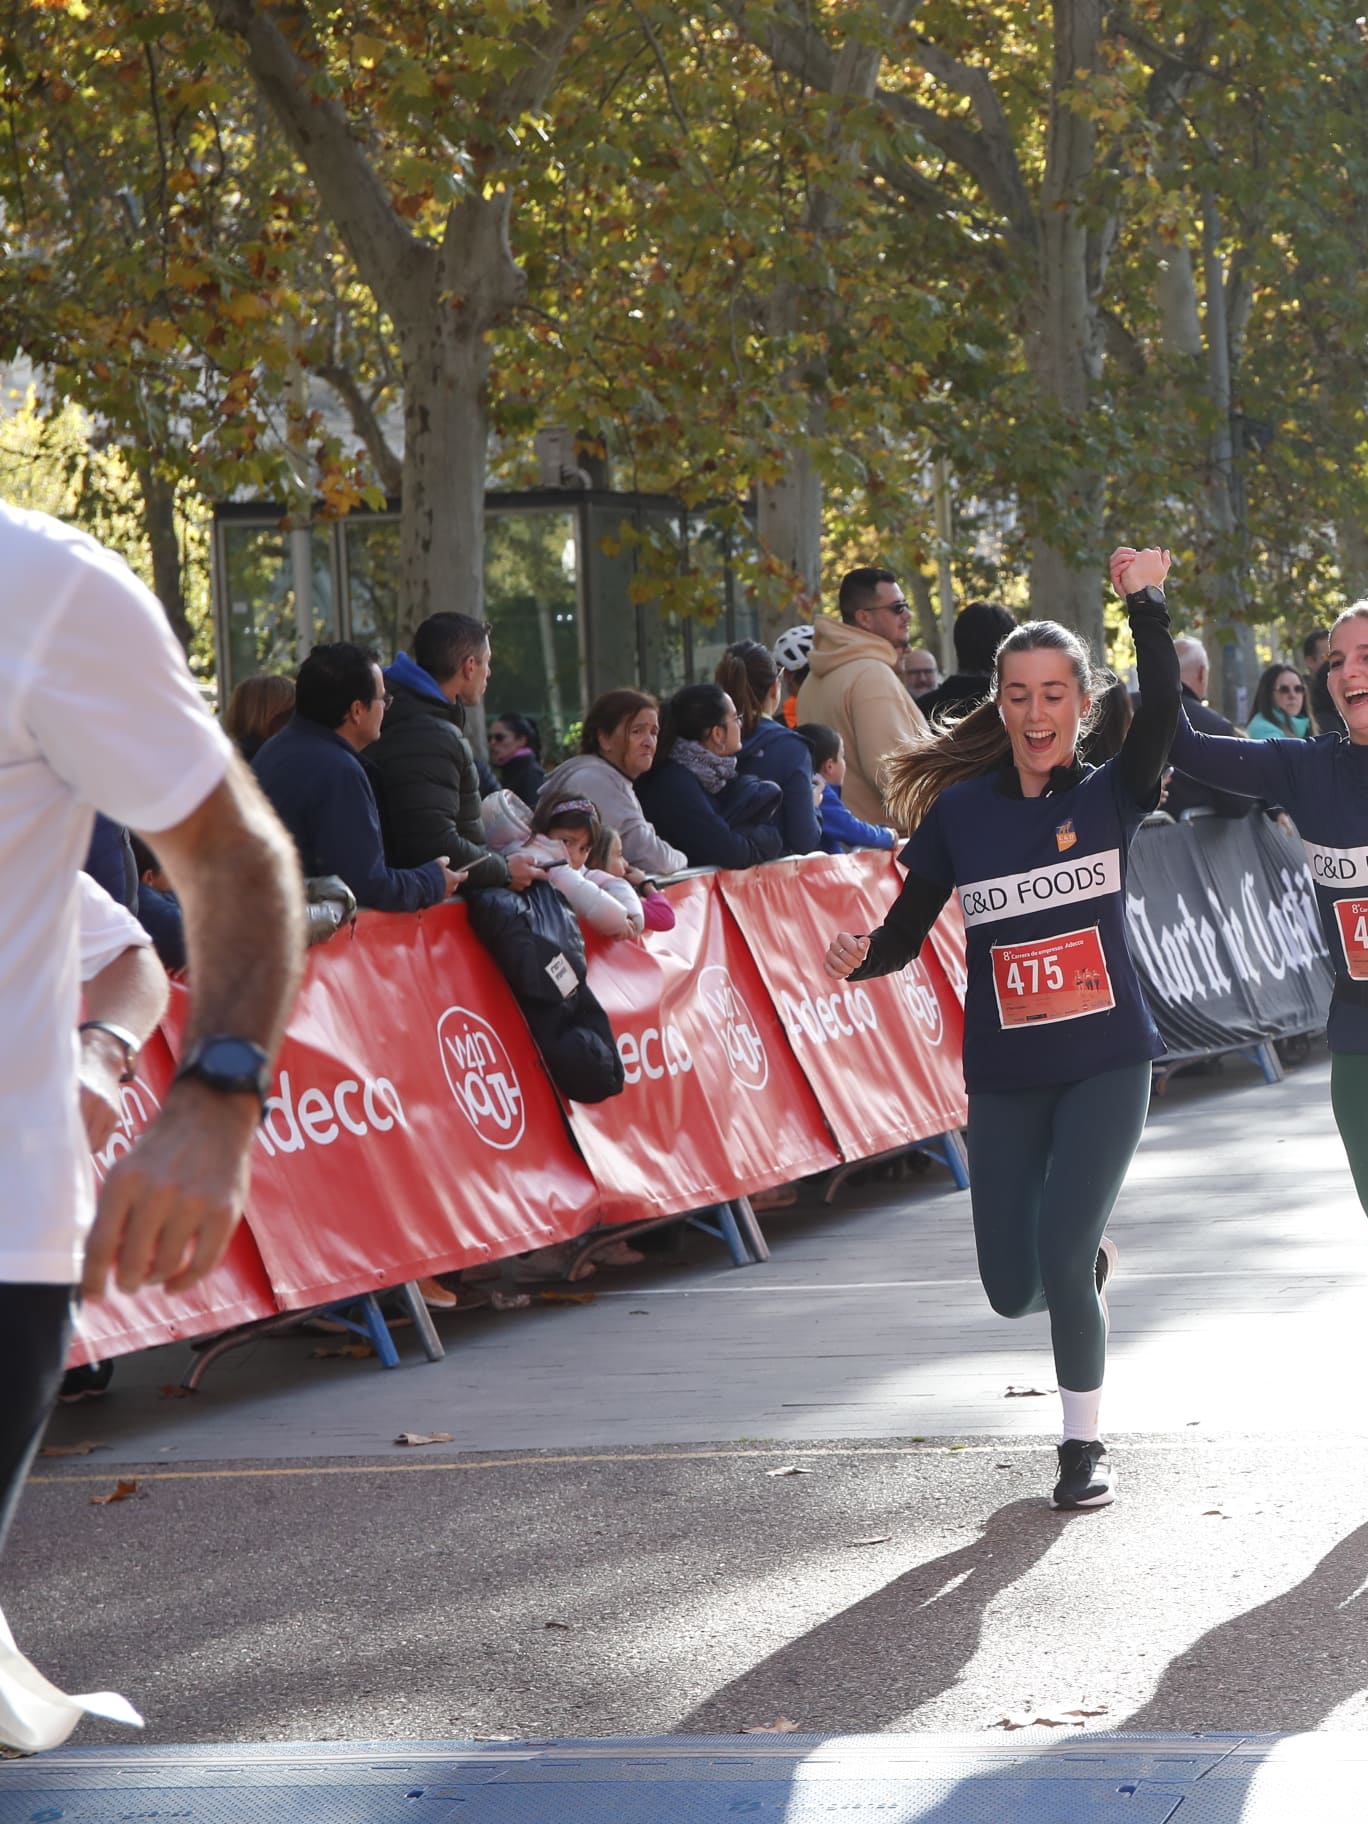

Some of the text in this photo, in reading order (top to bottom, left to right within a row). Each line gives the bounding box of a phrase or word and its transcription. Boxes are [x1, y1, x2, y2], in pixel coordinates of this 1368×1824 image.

[963, 862, 1106, 916] C&D FOODS
[1313, 854, 1357, 880] C&D
[1038, 946, 1063, 956] empresas
[1064, 939, 1084, 949] Adecco
[1007, 955, 1064, 996] 475
[779, 981, 878, 1046] Adecco
[616, 1023, 694, 1085] ecco
[255, 1069, 408, 1157] decco
